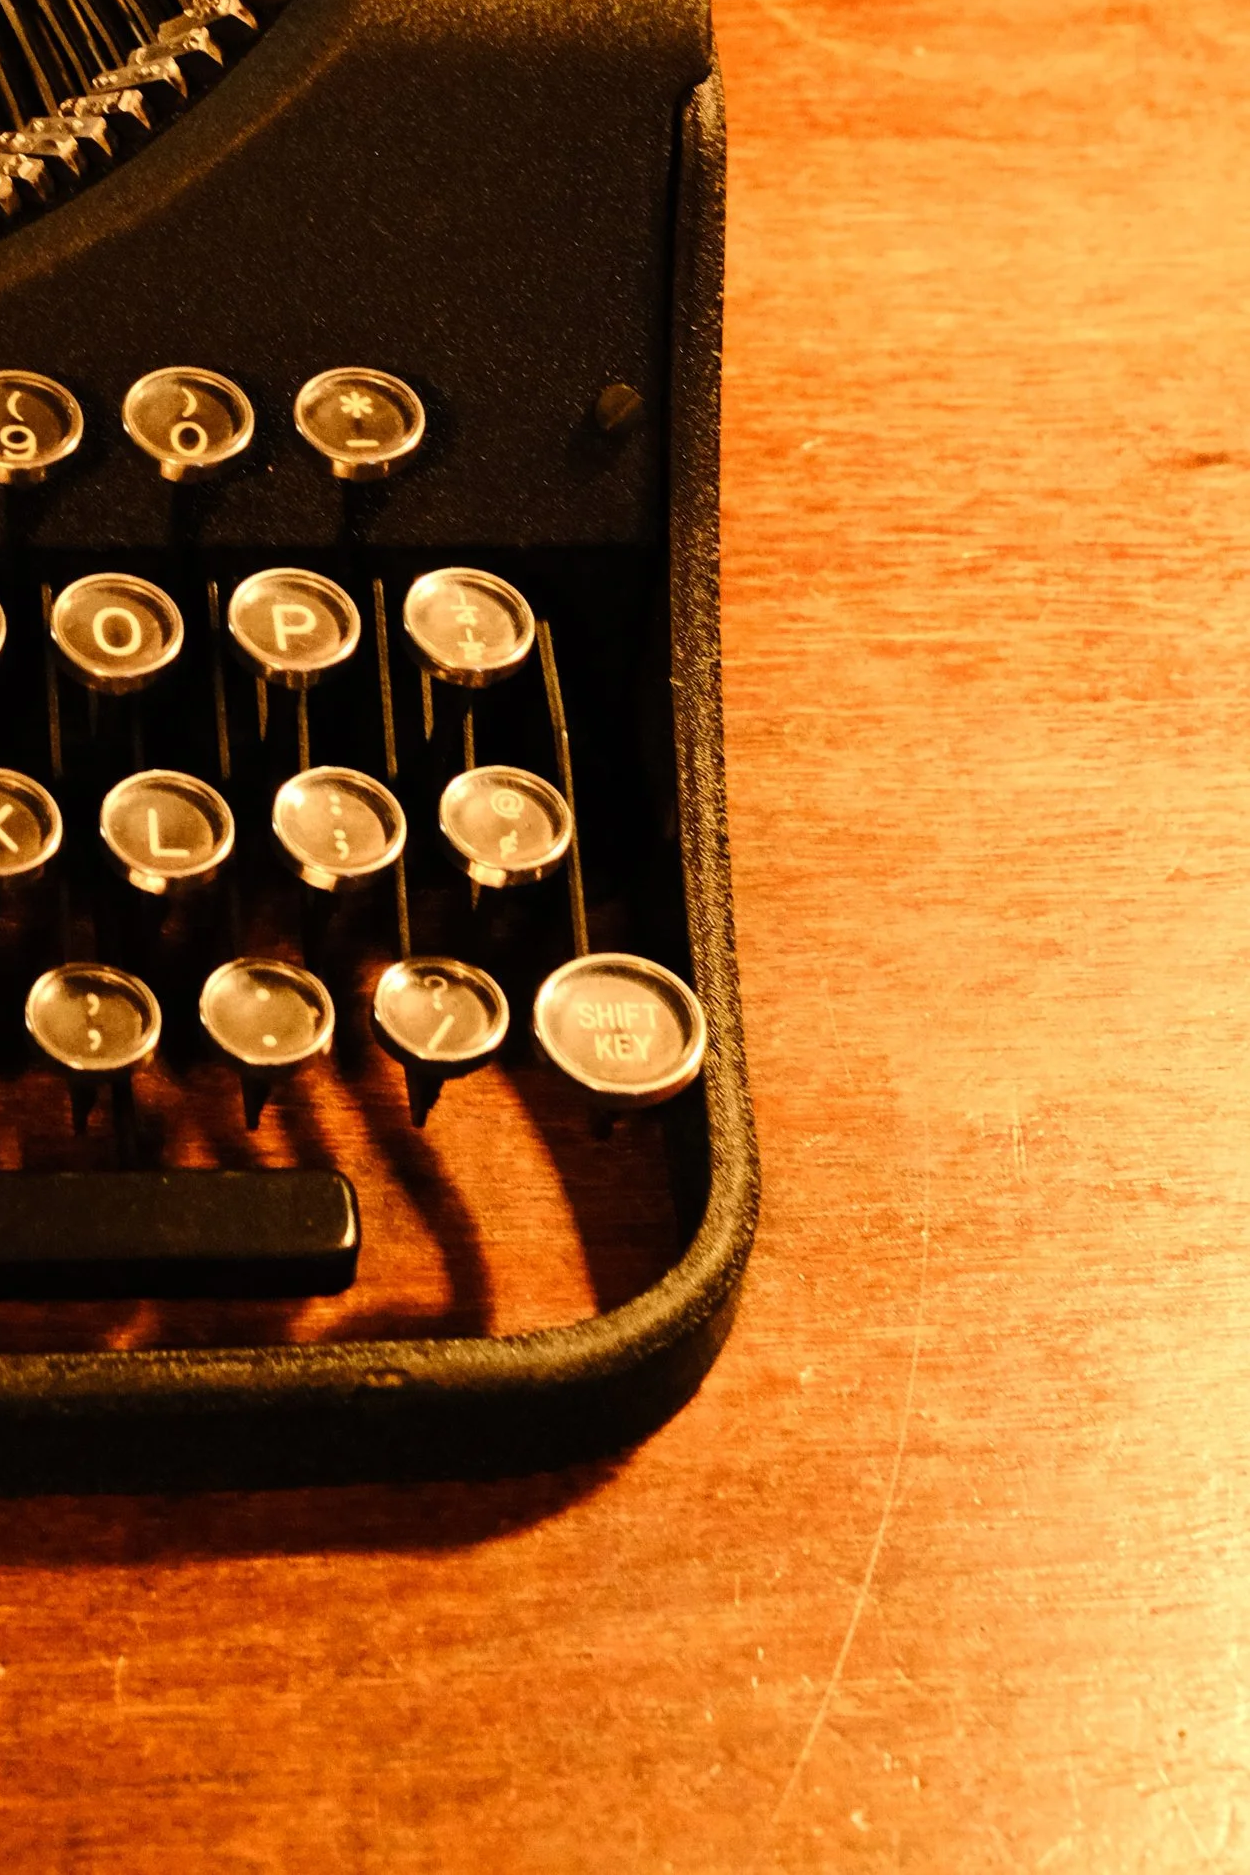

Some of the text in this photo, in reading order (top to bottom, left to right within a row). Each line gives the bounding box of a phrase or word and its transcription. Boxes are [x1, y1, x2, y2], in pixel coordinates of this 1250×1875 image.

[6, 390, 23, 422] (
[182, 387, 198, 418] )
[92, 606, 142, 657] O
[271, 604, 317, 653] P
[490, 788, 525, 820] @
[149, 808, 190, 857] L
[423, 976, 448, 1010] ?
[577, 1001, 659, 1030] SHIFT
[594, 1033, 652, 1061] KEY
